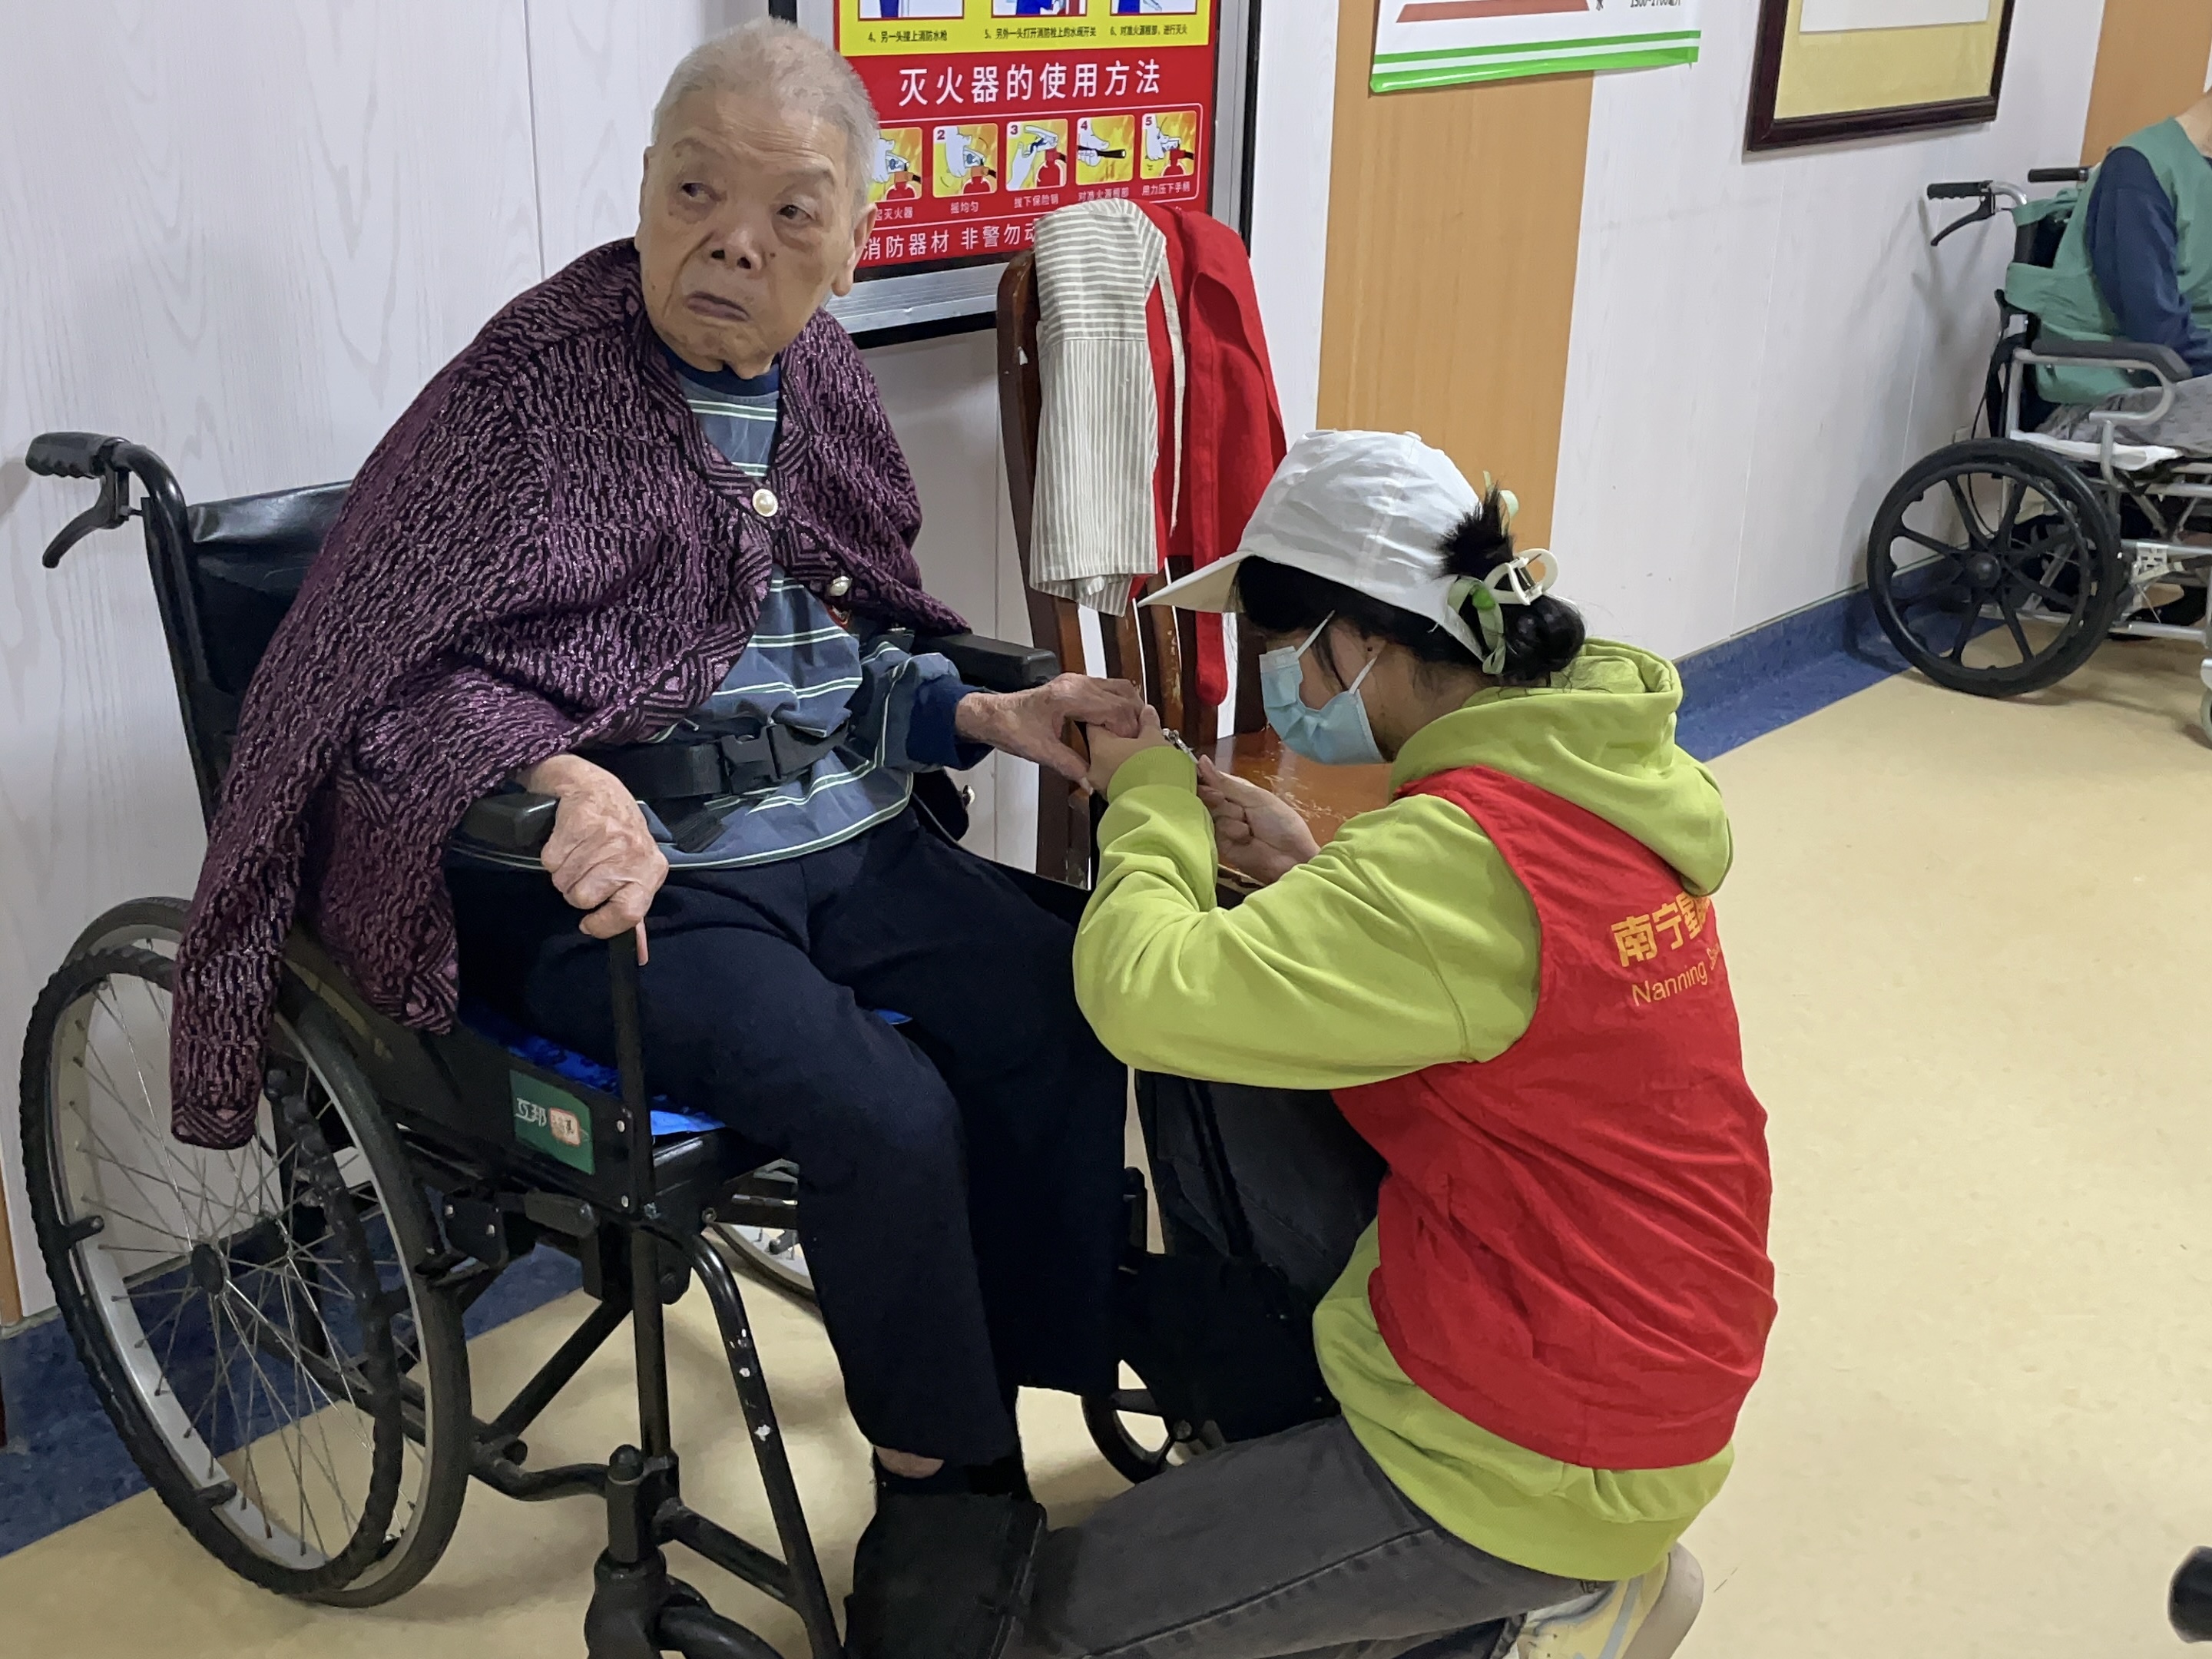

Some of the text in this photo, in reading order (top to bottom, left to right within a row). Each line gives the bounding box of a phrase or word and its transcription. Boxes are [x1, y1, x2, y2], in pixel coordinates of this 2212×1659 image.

[898, 59, 1161, 107] 灭火器的使用方法
[1010, 124, 1018, 135] 3
[1080, 120, 1088, 131] 4
[1145, 116, 1153, 126] 5
[936, 129, 945, 141] 2
[1141, 180, 1190, 197] 用力压下手柄
[950, 200, 979, 214] 摇均匀
[863, 229, 950, 261] 消防器材
[1611, 890, 1710, 968] 南宁星
[1631, 961, 1709, 1007] Nanning
[514, 1098, 547, 1127] 互邦
